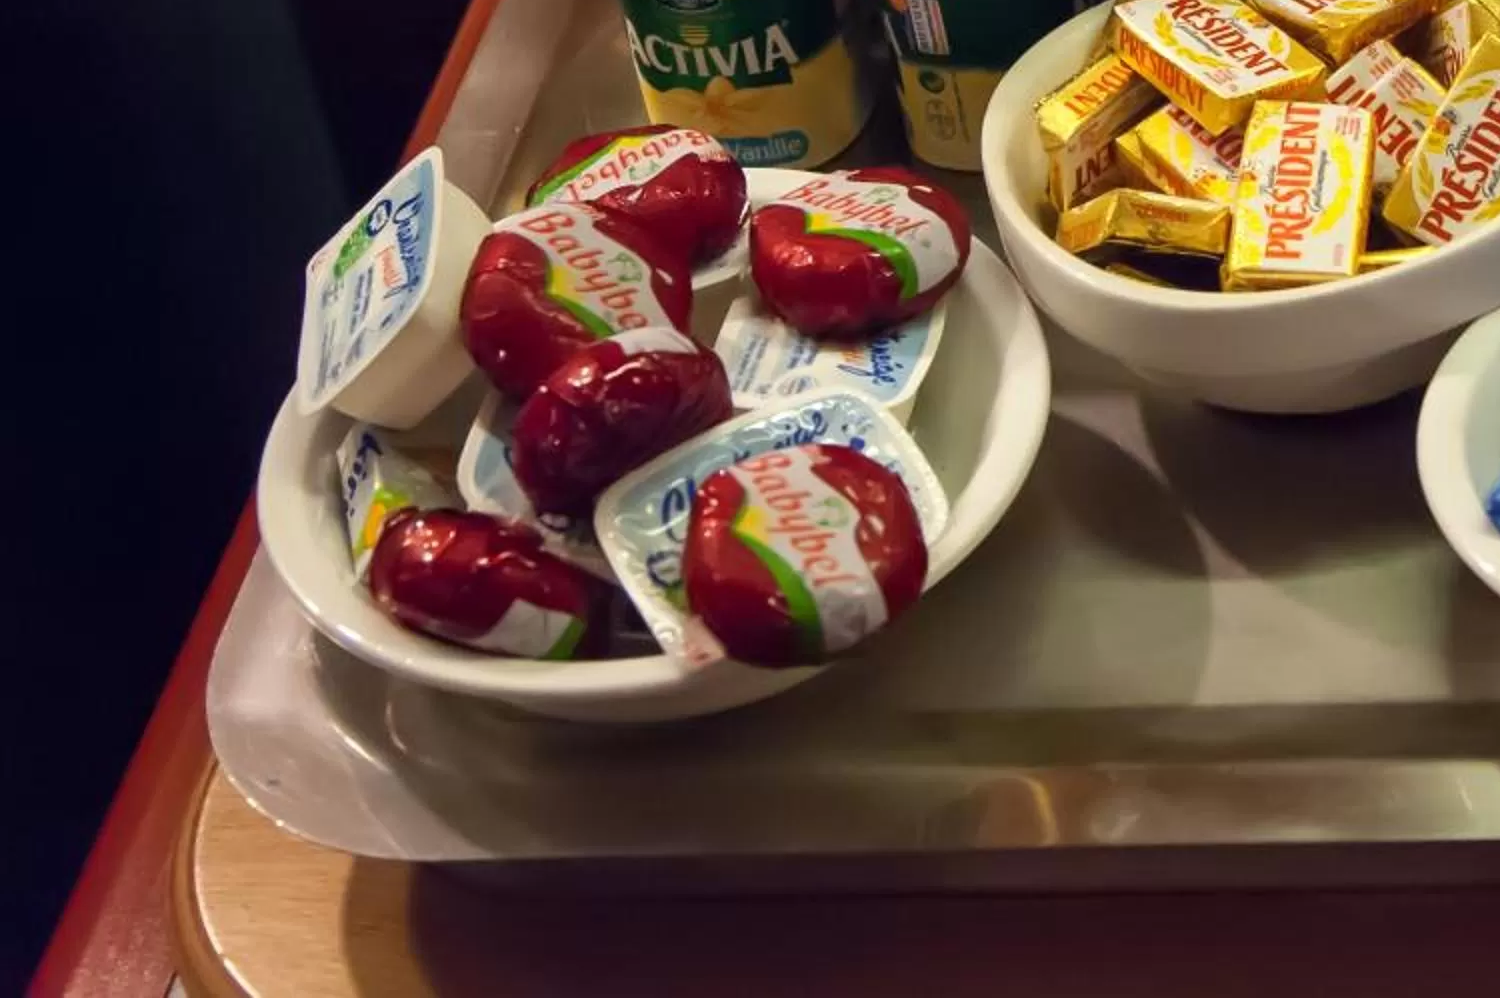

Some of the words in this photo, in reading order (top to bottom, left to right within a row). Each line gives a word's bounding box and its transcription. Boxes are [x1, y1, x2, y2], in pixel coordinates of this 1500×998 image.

[627, 18, 799, 77] ACTIVIA
[567, 130, 713, 202] Babybel
[779, 179, 933, 241] Babybel
[1264, 102, 1321, 260] PRÉSIDENT
[519, 211, 648, 330] Babybe
[740, 452, 861, 589] Babybel
